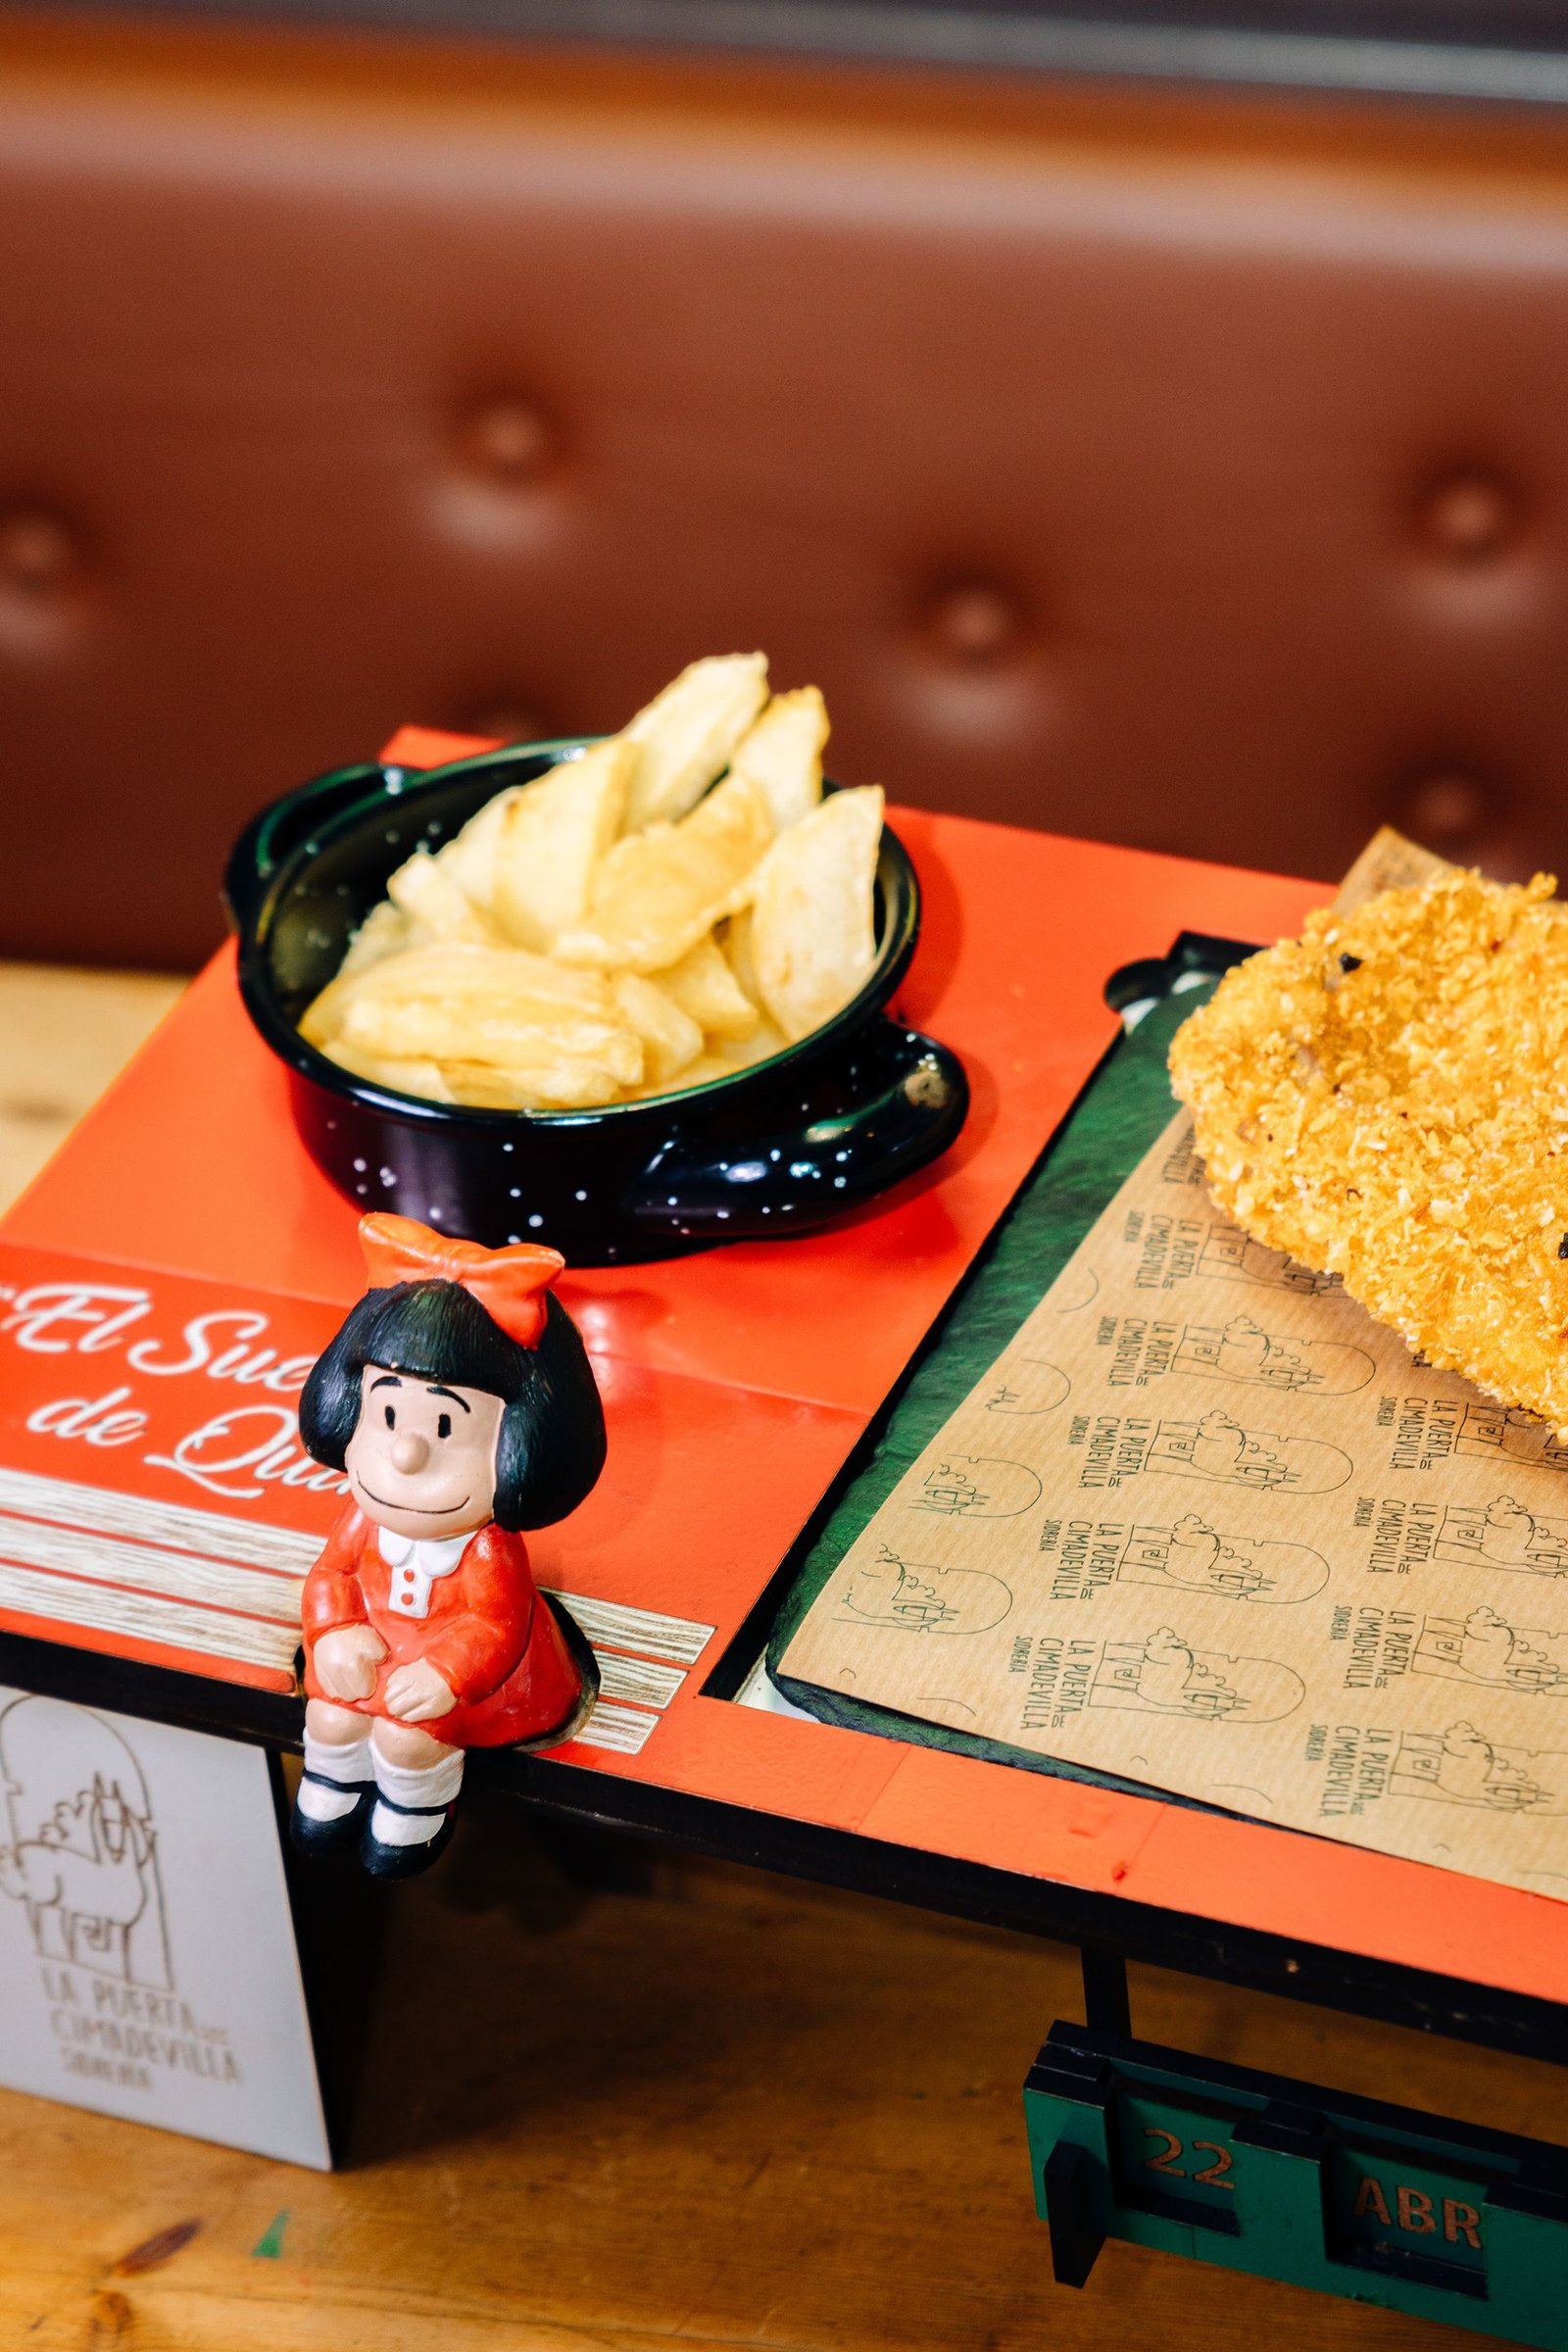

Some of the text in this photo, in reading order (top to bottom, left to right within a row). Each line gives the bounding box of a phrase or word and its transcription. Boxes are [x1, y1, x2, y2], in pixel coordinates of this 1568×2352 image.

[1133, 1214, 1174, 1289] CIMADEVILLA
[1165, 1238, 1200, 1279] PUERTA
[1178, 1219, 1203, 1233] LA
[0, 1282, 152, 1352] El
[1105, 1318, 1148, 1386] CIMADEVILLA
[1136, 1321, 1178, 1386] LA PUERTA DE
[26, 1386, 148, 1446] de
[1078, 1416, 1120, 1488] CIMADEVILLA
[1390, 1397, 1428, 1469] CIMADEVILLA
[1419, 1399, 1458, 1470] LA PUERTA DE
[1108, 1418, 1152, 1488] LA PUERTA DE
[1050, 1520, 1093, 1599] CIMADEVILLA
[1080, 1523, 1125, 1599] LA PUERTA DE
[1367, 1499, 1406, 1573] CIMADEVILLA
[1397, 1502, 1439, 1575] LA PUERTA DE
[1020, 1638, 1064, 1729] CIMADEVILLA
[1343, 1607, 1384, 1689] CIMADEVILLA
[1374, 1610, 1416, 1690] LA PUERTA DE
[1052, 1641, 1096, 1728] LA PUERTA DE
[1317, 1726, 1360, 1817] CIMADEVILLA
[1363, 1729, 1395, 1744] LA
[1352, 1751, 1389, 1800] PUERTA
[1144, 2128, 1483, 2250] 22 ABR
